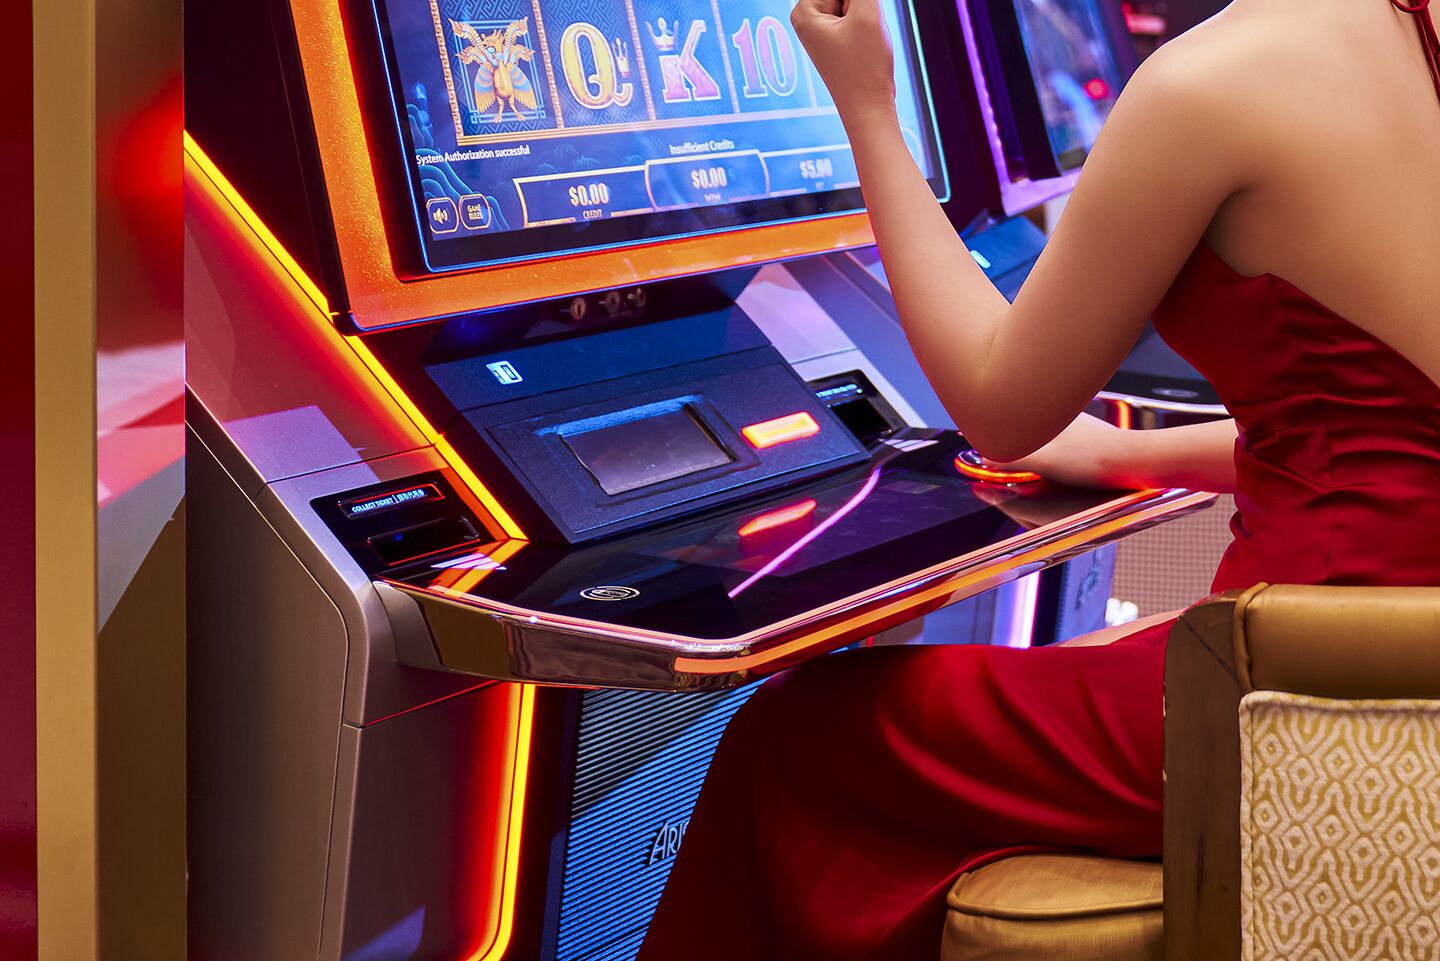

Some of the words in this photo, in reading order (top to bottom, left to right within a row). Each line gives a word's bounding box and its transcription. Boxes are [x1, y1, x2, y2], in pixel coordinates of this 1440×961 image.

[560, 22, 633, 109] Q
[658, 19, 721, 103] K
[732, 16, 797, 97] 10
[416, 154, 444, 166] System
[445, 149, 494, 162] Authorization
[495, 145, 531, 157] successful
[669, 142, 709, 155] Insufficient
[709, 139, 735, 150] Credits
[691, 167, 727, 189] $0.00
[568, 183, 609, 207] $0.00
